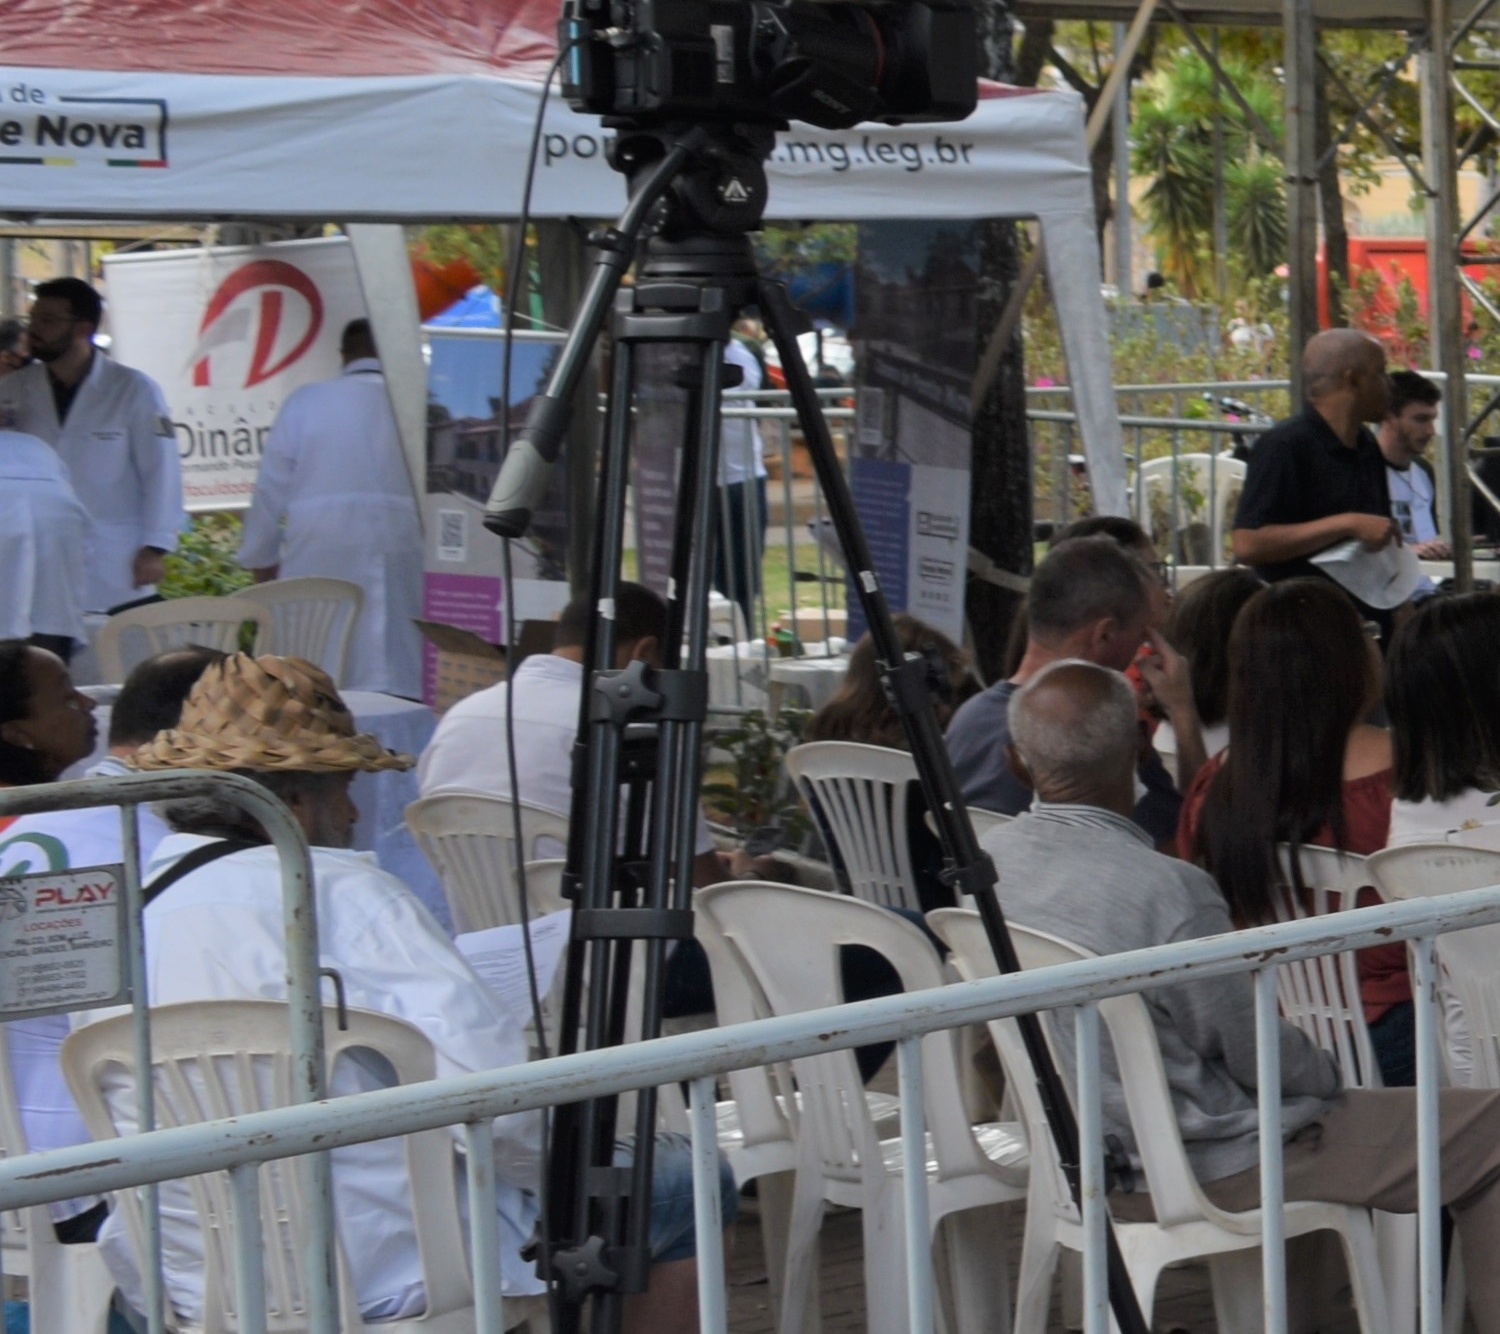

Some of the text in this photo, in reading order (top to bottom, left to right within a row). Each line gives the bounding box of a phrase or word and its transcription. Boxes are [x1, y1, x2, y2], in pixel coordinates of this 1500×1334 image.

[11, 83, 46, 105] de
[35, 116, 146, 150] Nova
[35, 881, 114, 907] PLAY
